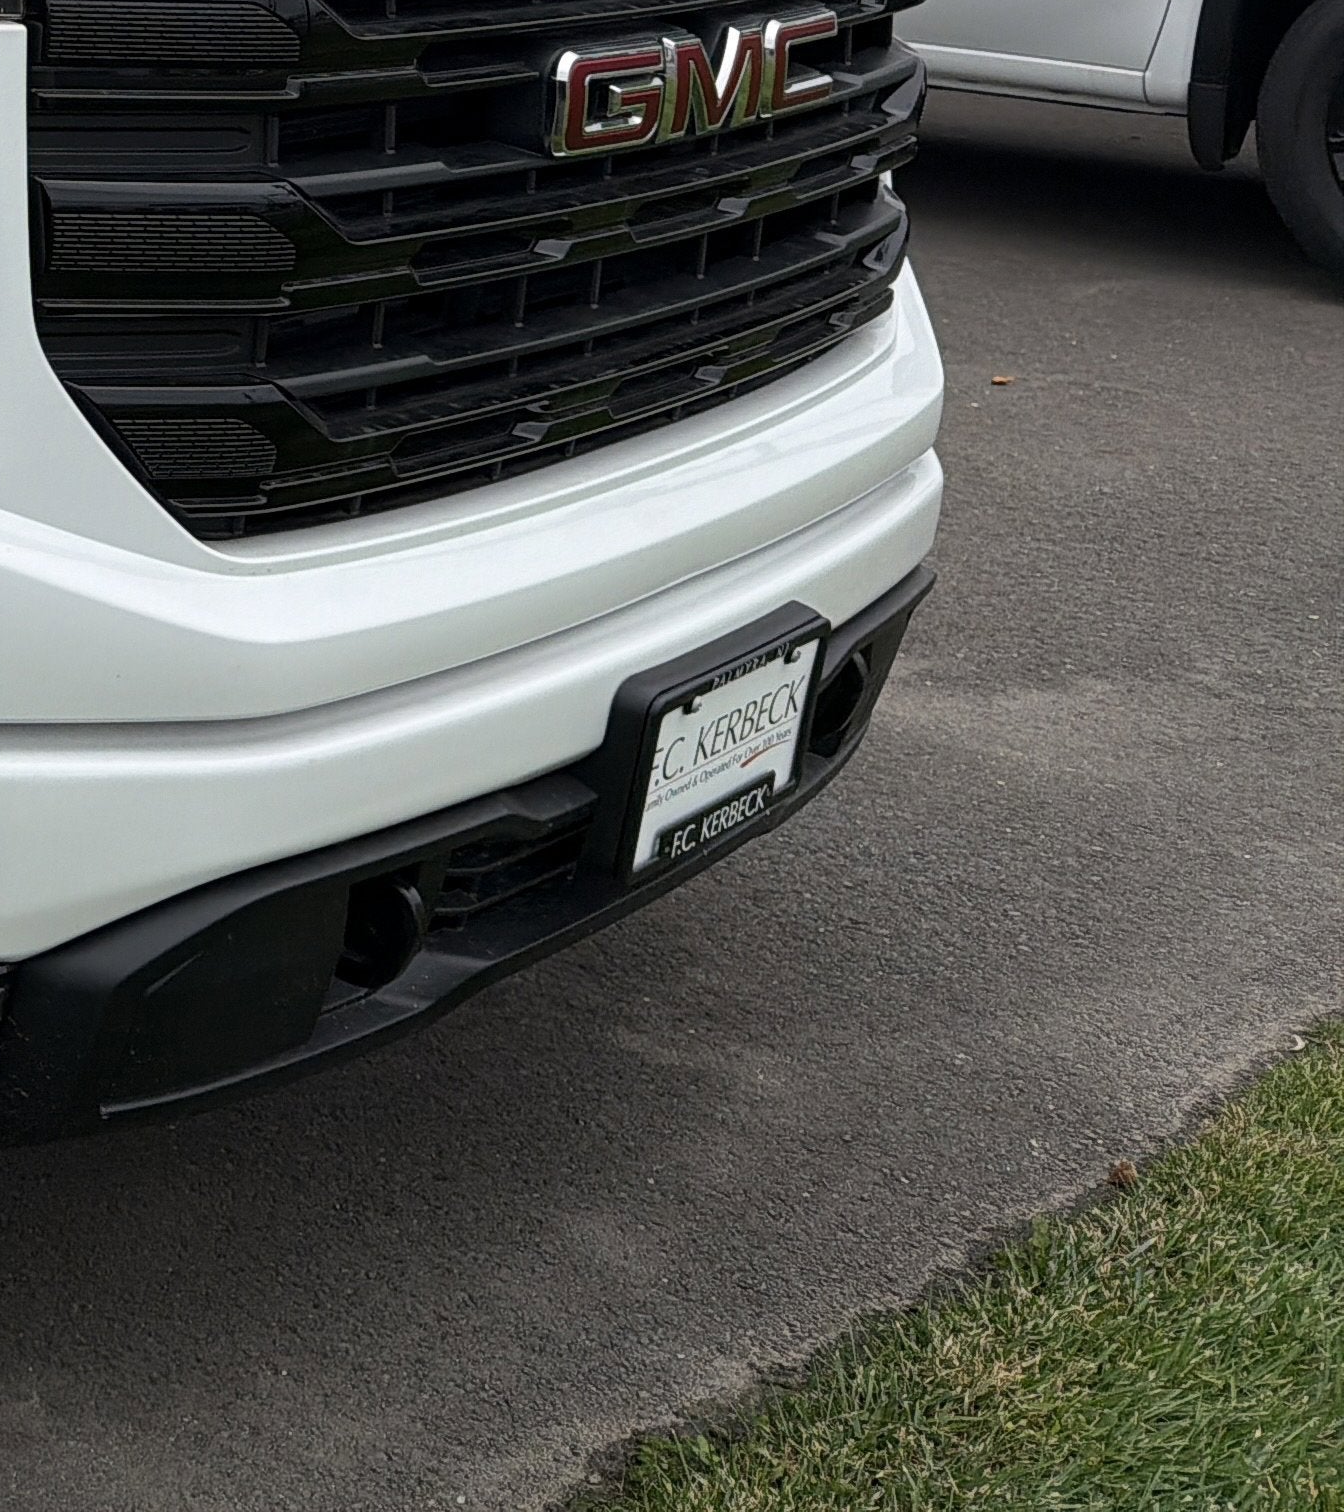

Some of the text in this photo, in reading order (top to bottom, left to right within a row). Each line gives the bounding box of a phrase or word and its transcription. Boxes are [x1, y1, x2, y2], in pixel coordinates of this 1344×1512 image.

[551, 9, 839, 157] GMC
[693, 675, 806, 767] KERBECK
[670, 783, 769, 859] F.C. KERBECK
